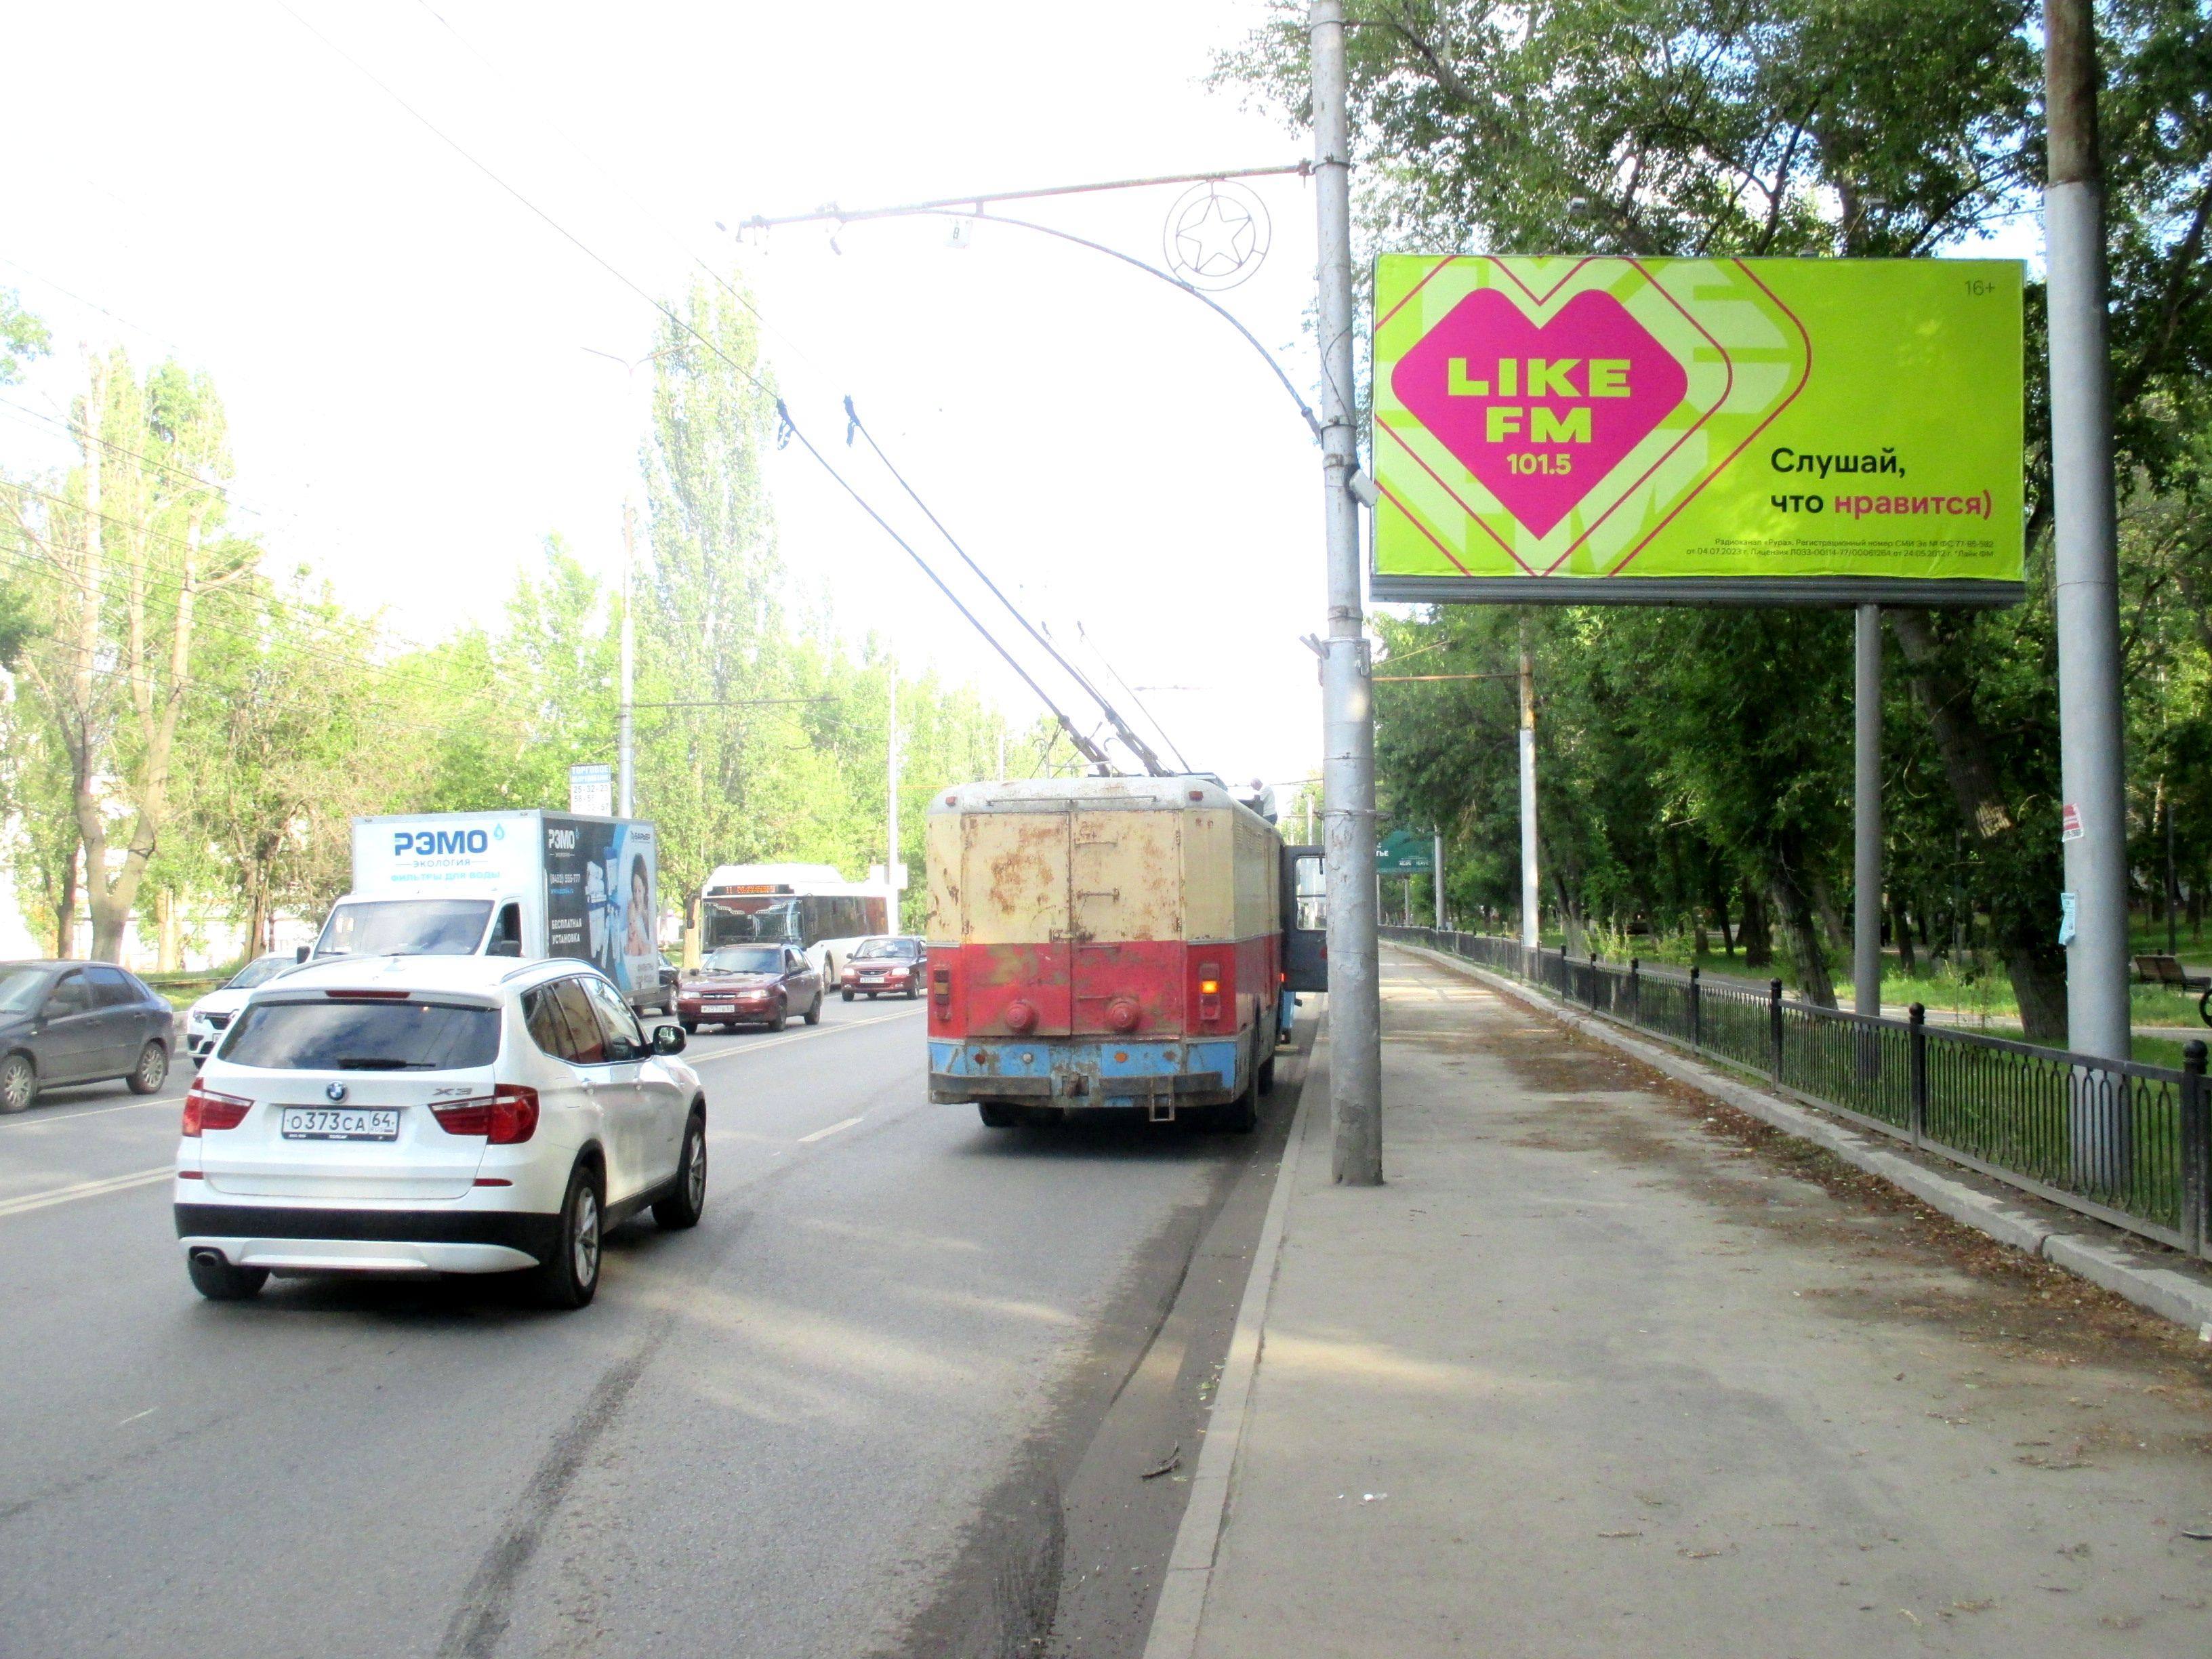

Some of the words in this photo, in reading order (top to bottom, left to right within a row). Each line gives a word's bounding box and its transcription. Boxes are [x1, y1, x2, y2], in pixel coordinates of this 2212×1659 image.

[1965, 279, 1996, 296] 16+
[1448, 357, 1631, 398] LIKE
[1486, 407, 1591, 443] FM
[1507, 453, 1572, 475] 101.5
[1770, 447, 1906, 480] Слушай,
[1770, 494, 1824, 514] что
[1834, 488, 1992, 521] нравится)
[1697, 548, 1742, 556] 04.07.2023
[1750, 548, 1788, 556] Лицензия
[394, 829, 489, 856] РЭМО
[548, 829, 575, 849] РЭМО
[413, 859, 471, 868] ЭКОЛОГИЯ
[390, 873, 442, 882] ФИЛЬТРЫ
[445, 872, 466, 880] ДЛЯ
[469, 871, 501, 880] ВОДЫ
[552, 918, 582, 930] БЕСПЛАТНАЯ
[552, 933, 581, 945] УСТАНОВКА
[432, 1088, 473, 1096] X3
[371, 1112, 391, 1127] 64
